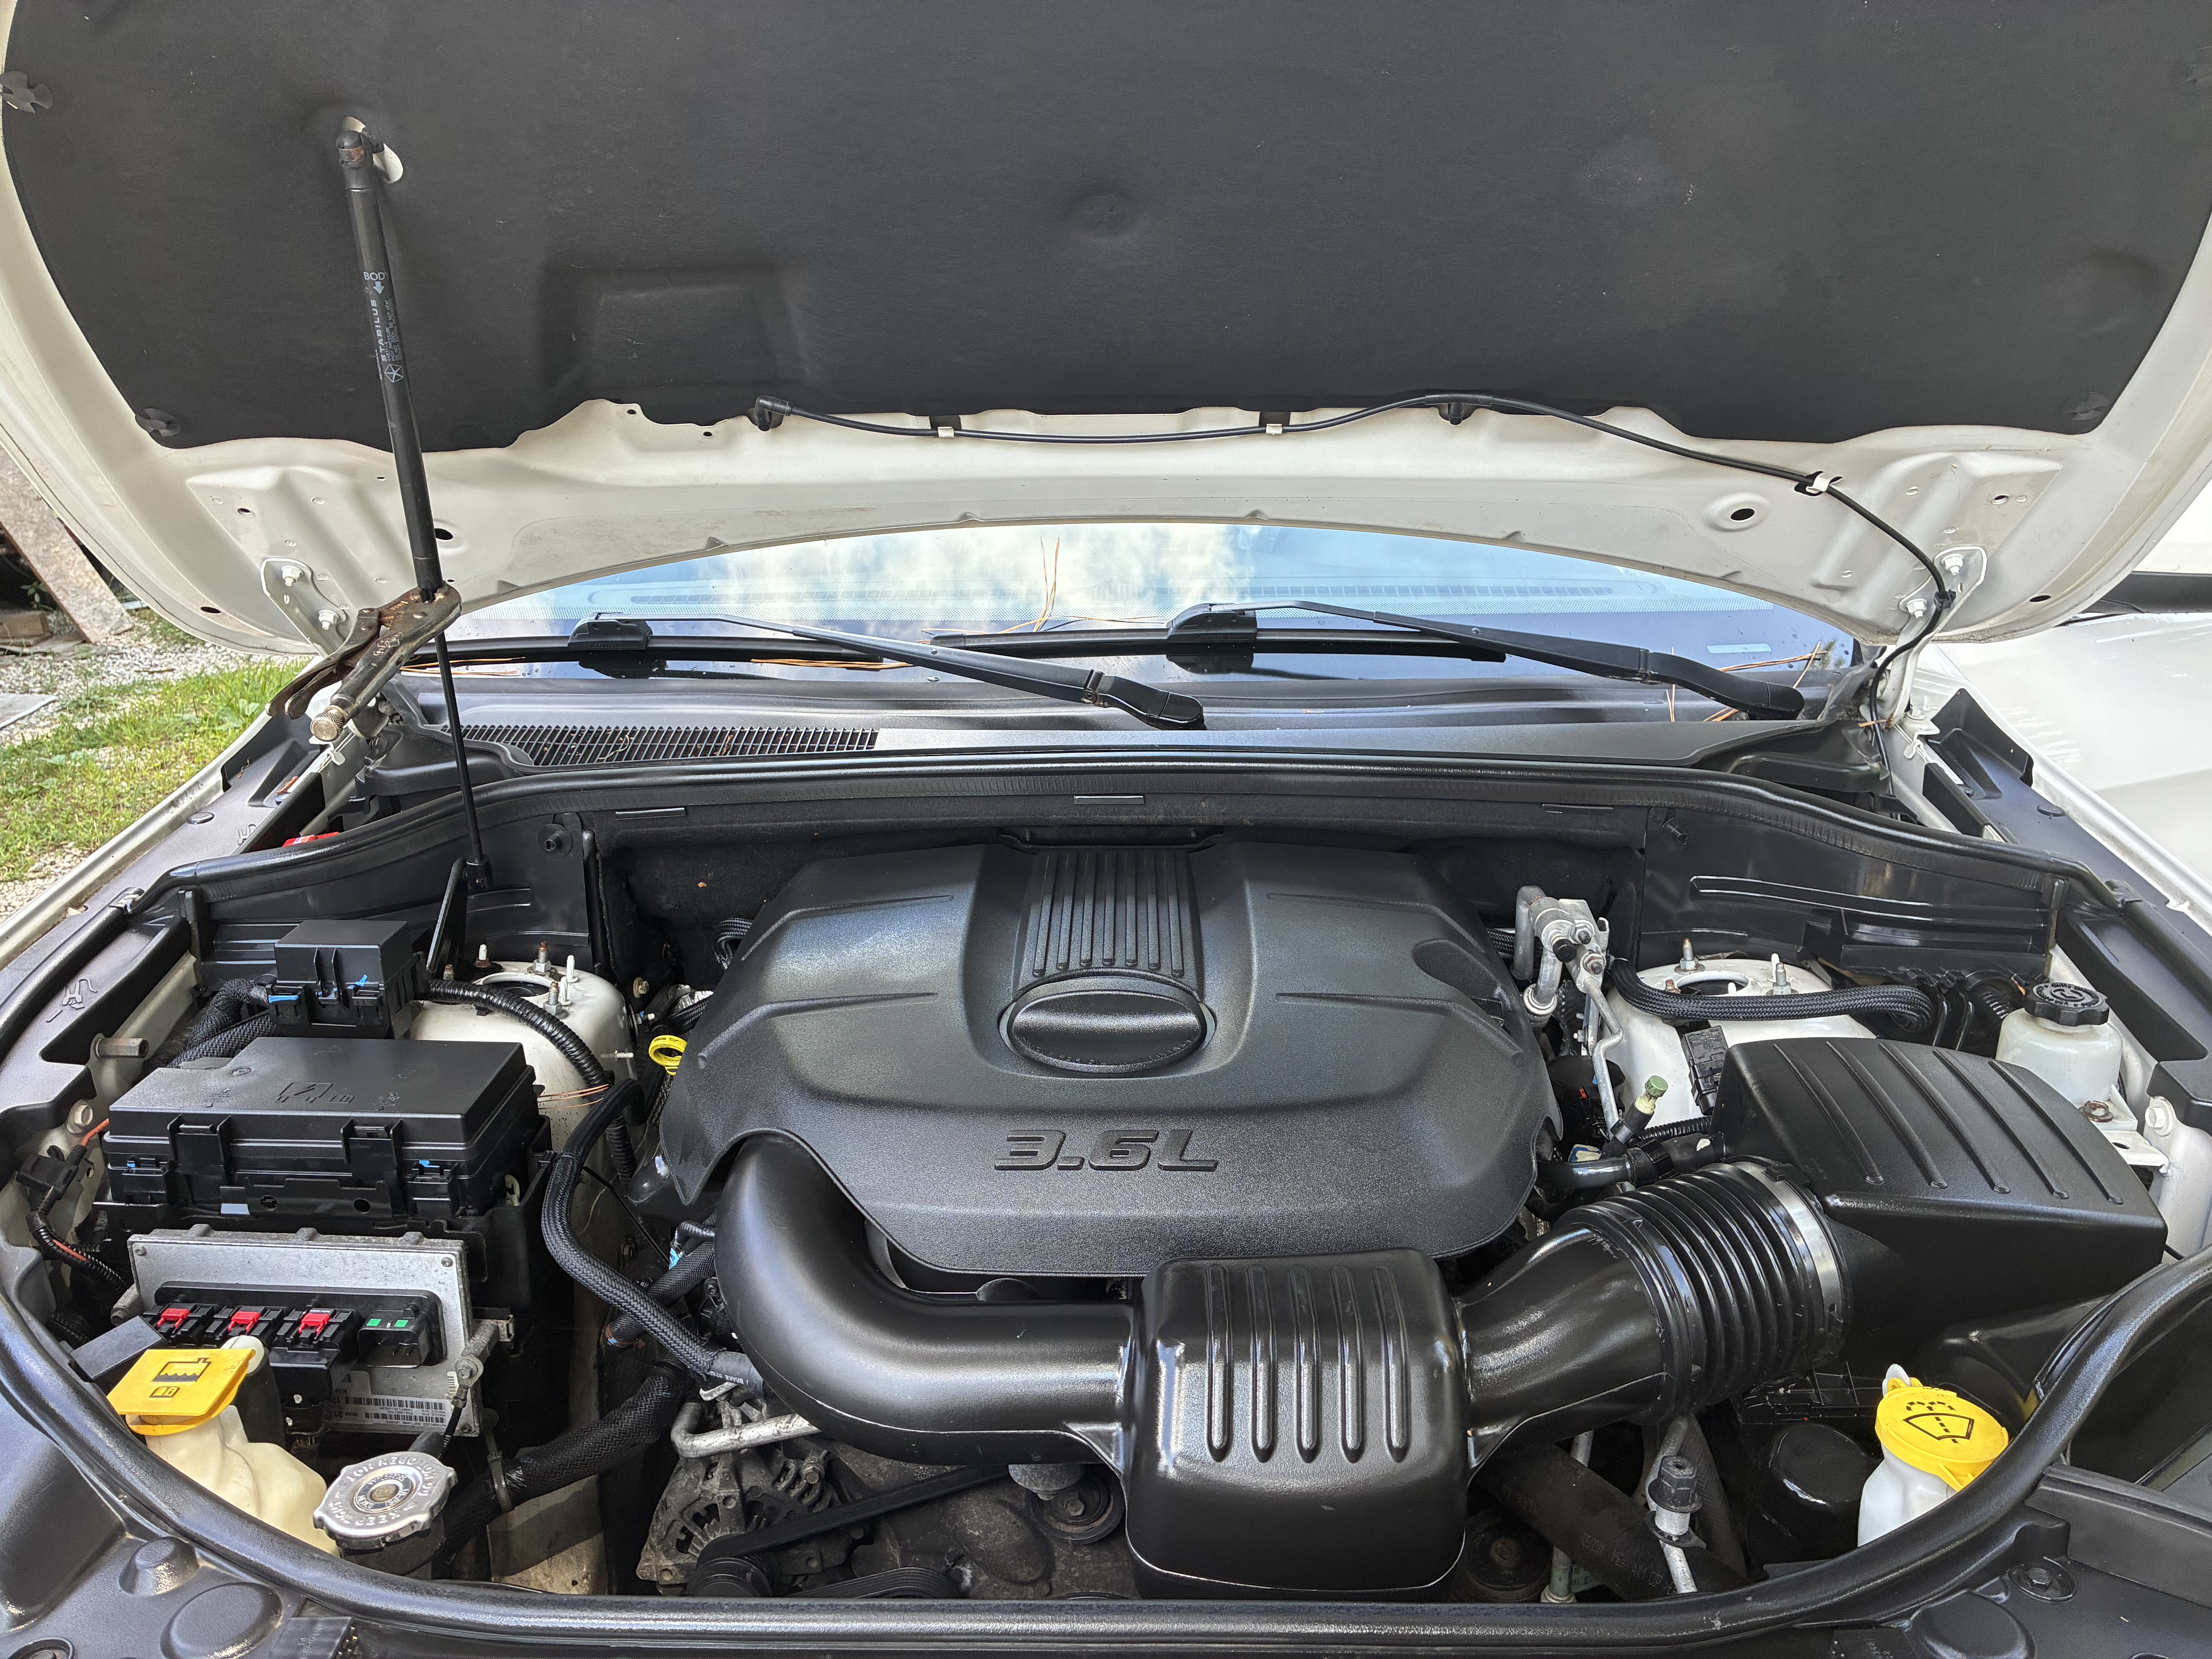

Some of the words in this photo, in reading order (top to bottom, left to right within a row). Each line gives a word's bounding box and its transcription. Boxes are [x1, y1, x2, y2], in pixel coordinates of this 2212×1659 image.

[370, 299, 387, 362] STABILUS
[994, 1128, 1218, 1172] 3.6L
[725, 1374, 744, 1384] BRAKE
[385, 1489, 409, 1506] 18-PSI
[355, 1510, 401, 1526] KEEP
